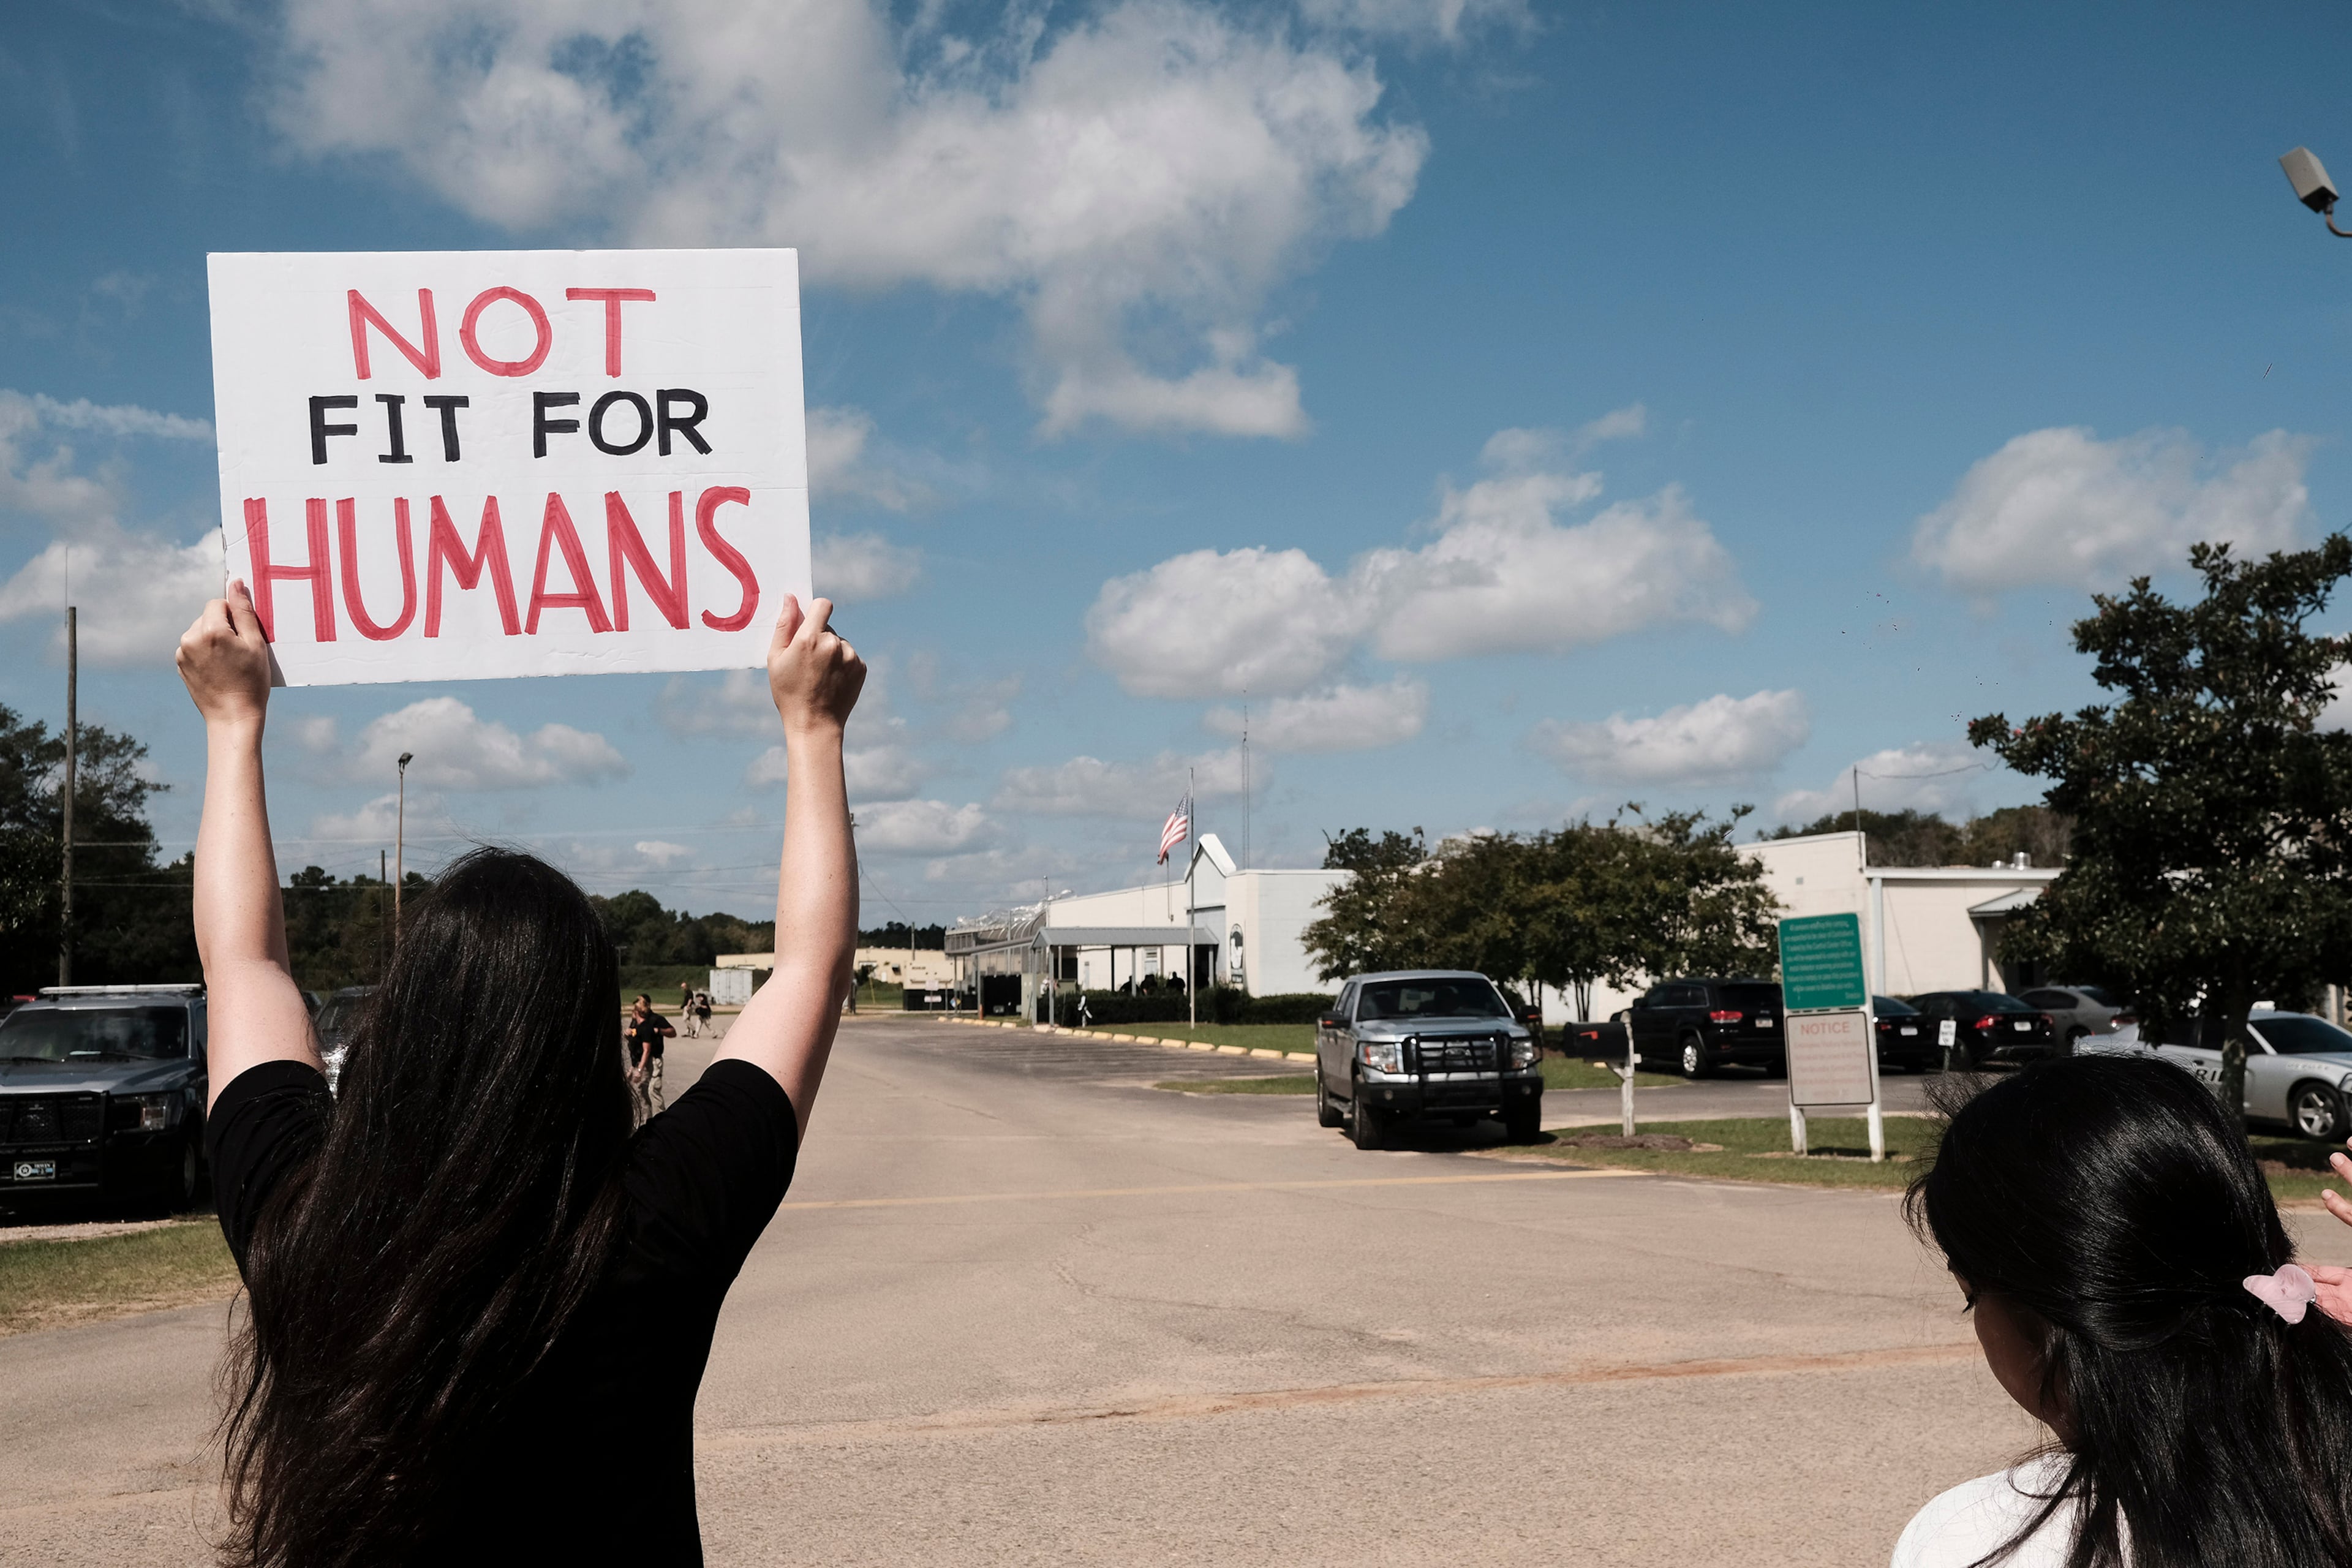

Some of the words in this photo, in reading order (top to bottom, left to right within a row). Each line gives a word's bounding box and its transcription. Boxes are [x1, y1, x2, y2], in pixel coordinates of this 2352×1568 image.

[347, 286, 656, 380] NOT
[309, 394, 469, 465] FIT
[533, 388, 712, 458] FOR
[243, 486, 760, 643] HUMANS
[1800, 1021, 1850, 1035] NOTICE
